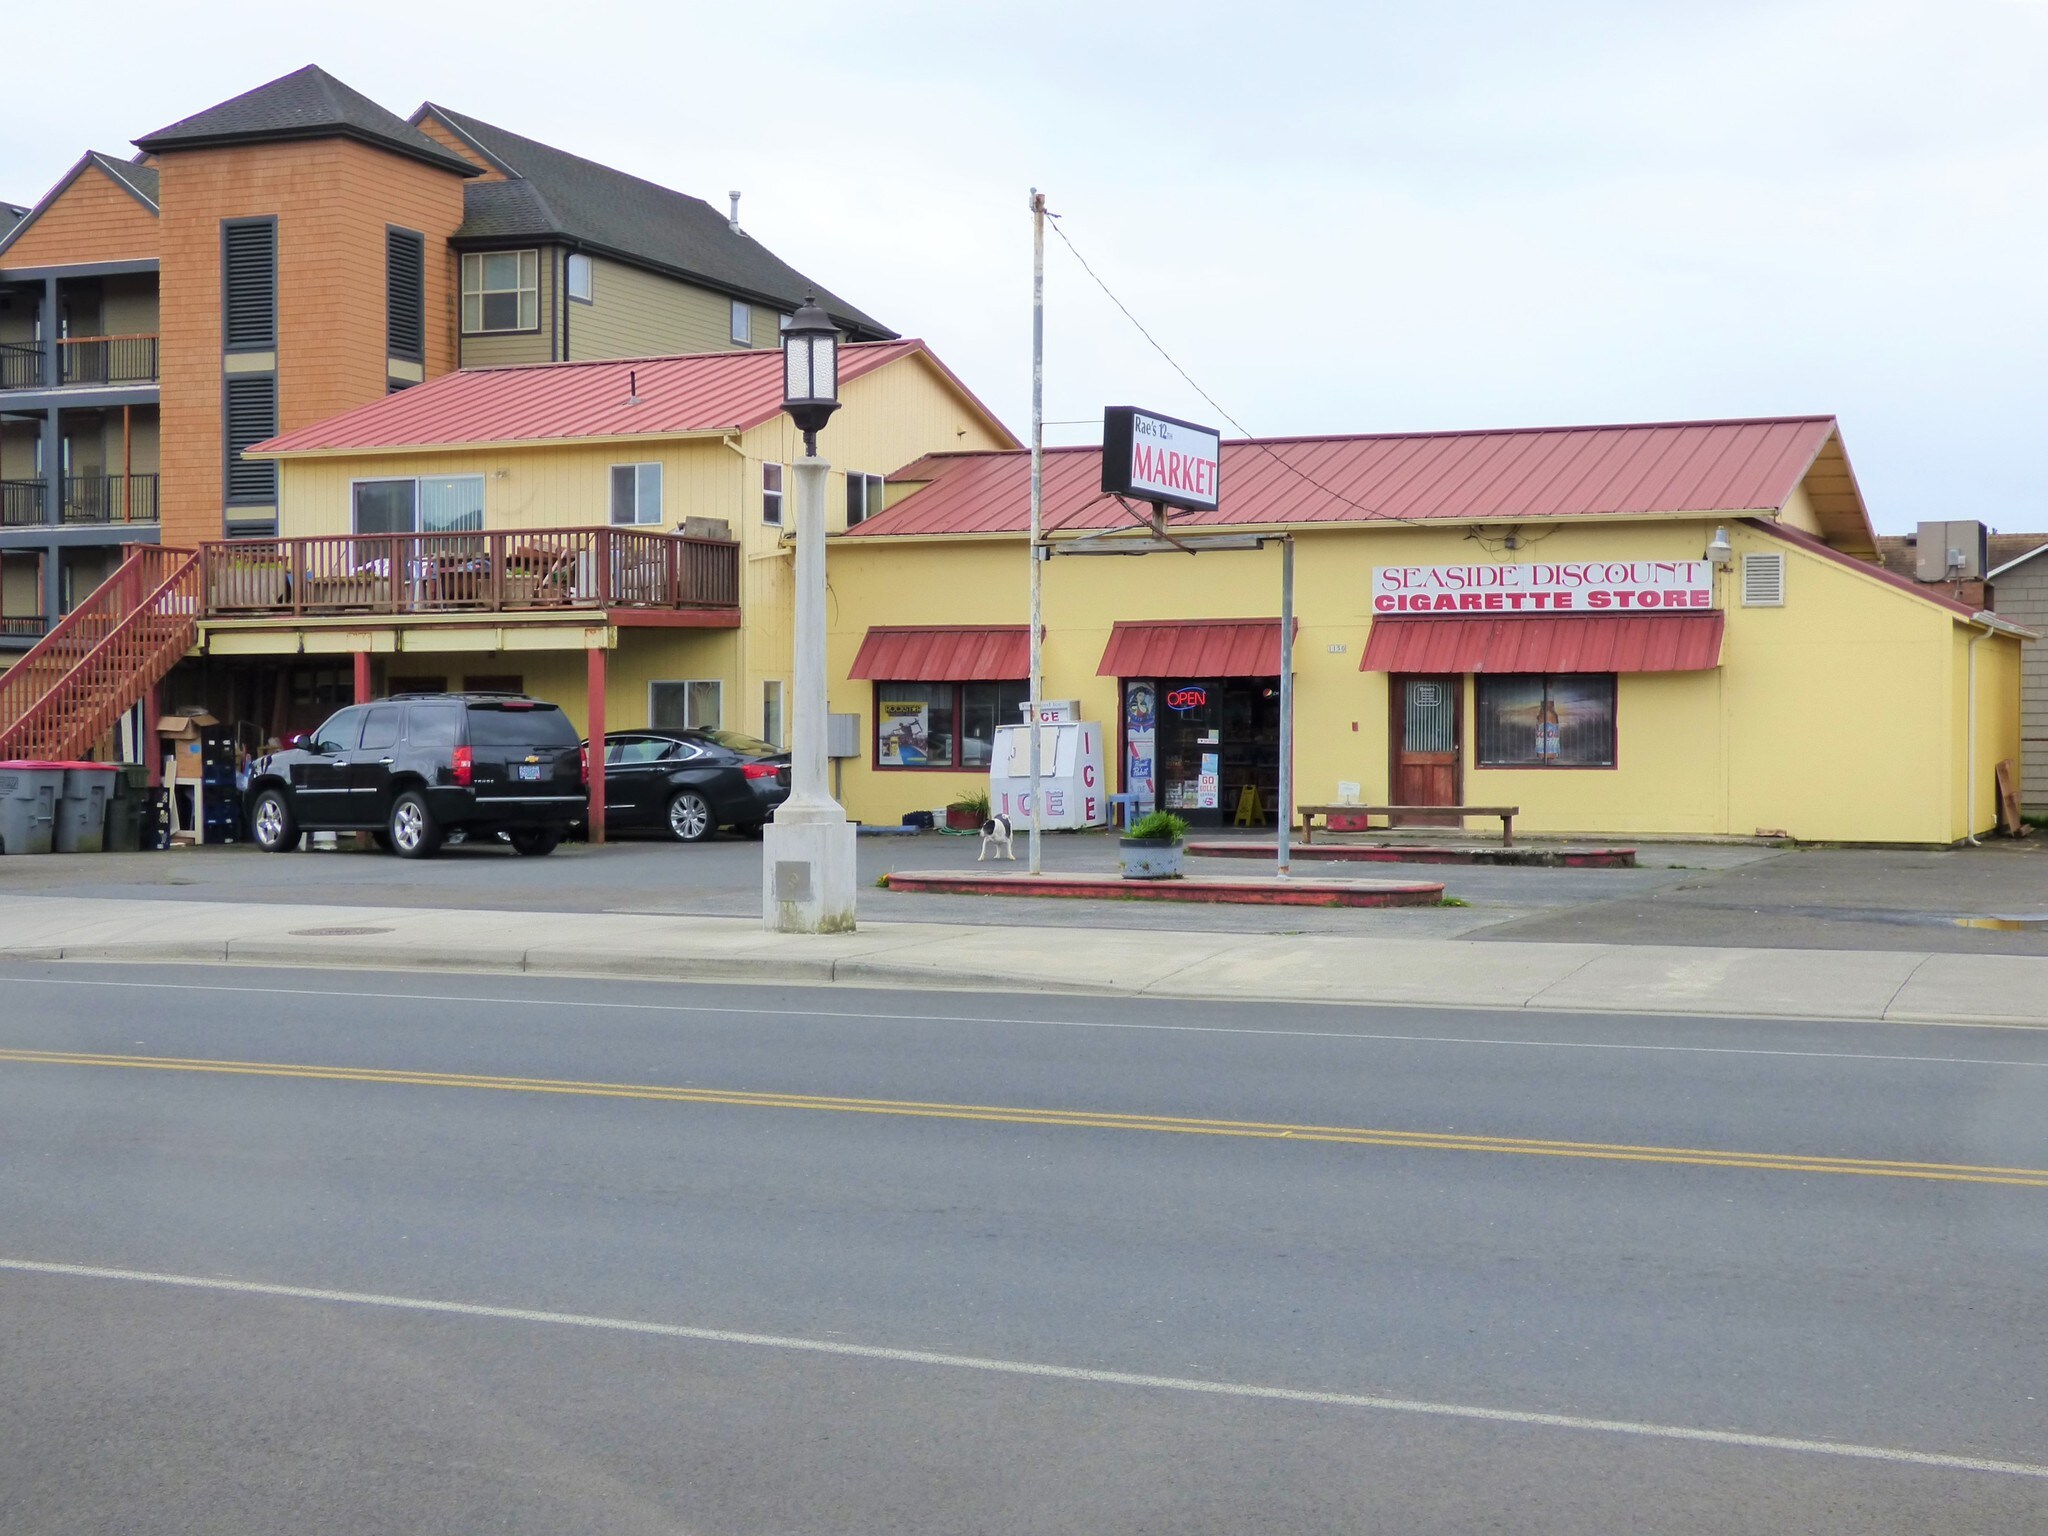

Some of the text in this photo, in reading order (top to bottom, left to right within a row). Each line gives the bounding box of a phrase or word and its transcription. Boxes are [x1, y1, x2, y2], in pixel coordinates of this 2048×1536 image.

[1135, 416, 1157, 437] Rae's
[1133, 442, 1217, 496] MARKET
[1382, 562, 1701, 591] SEASIDE DISCOUNT
[1374, 590, 1710, 612] CIGARETTE STORE
[1167, 691, 1206, 706] OPEN
[1083, 732, 1096, 821] ICE
[1202, 776, 1215, 785] GO
